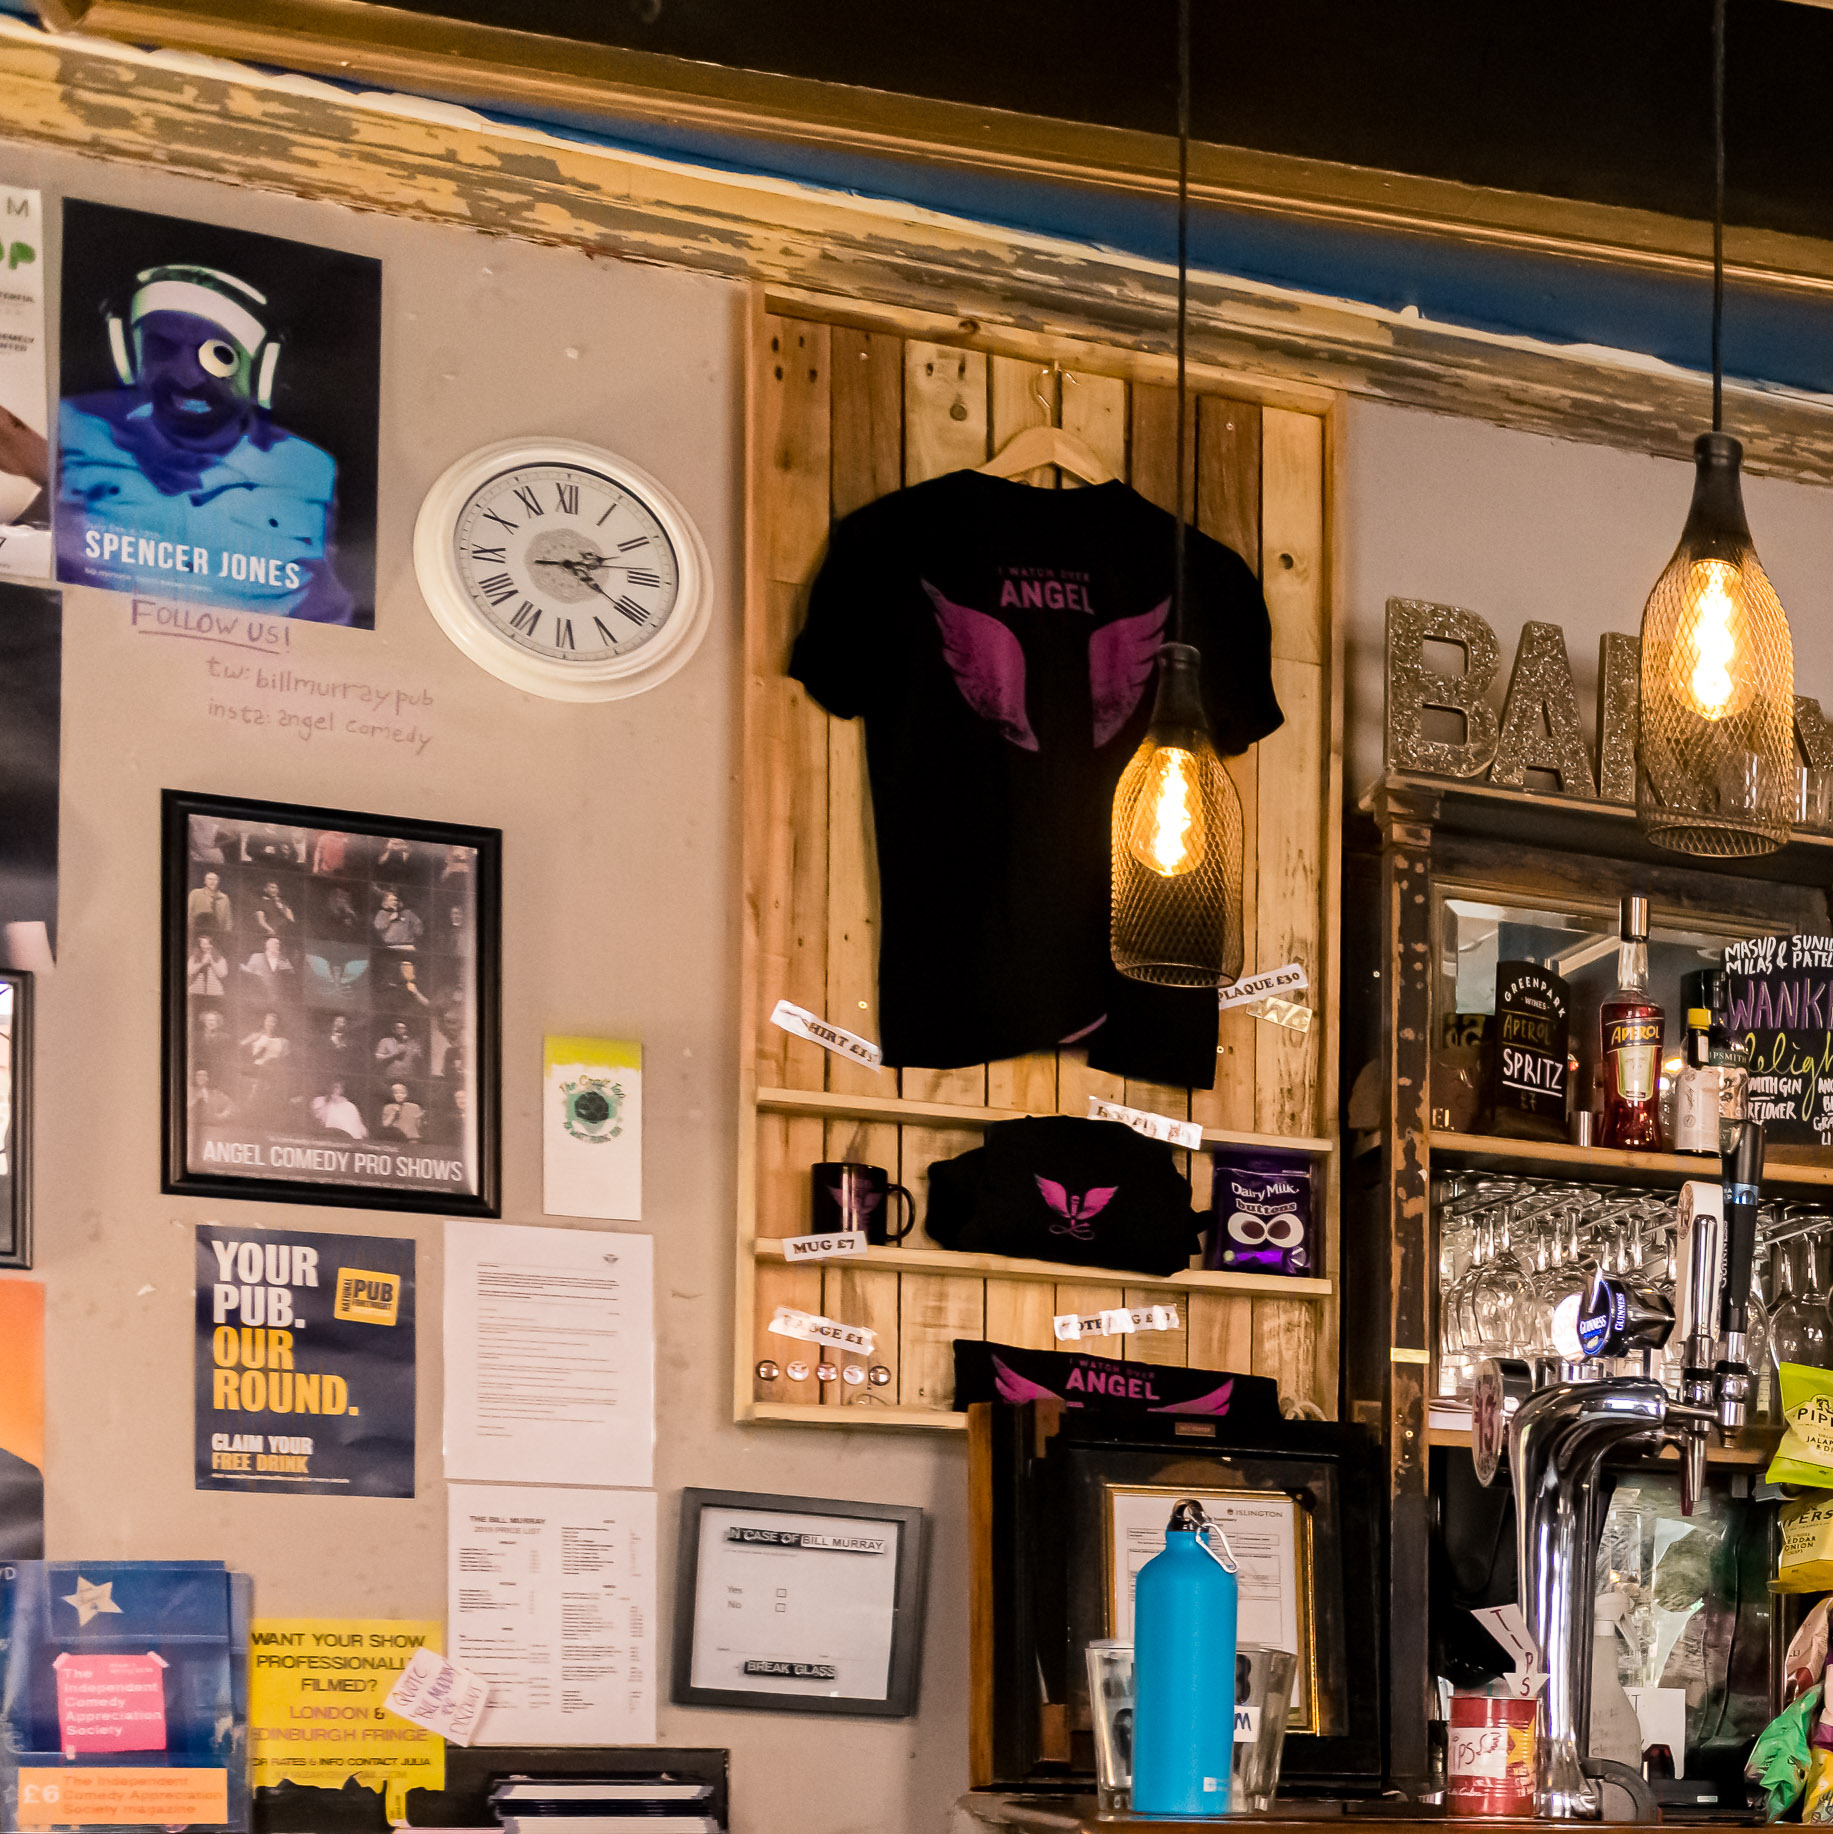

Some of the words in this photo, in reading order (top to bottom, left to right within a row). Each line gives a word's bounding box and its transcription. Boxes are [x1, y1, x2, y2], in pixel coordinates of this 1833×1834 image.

[85, 530, 208, 575] SPENCER
[218, 551, 301, 589] JONES
[1000, 579, 1095, 615] ANGEL
[131, 598, 239, 634] FOLLOW
[247, 621, 291, 653] US!
[1725, 936, 1776, 962] MASUD
[1726, 957, 1773, 975] MILAS
[1792, 950, 1833, 968] PATEL
[1276, 971, 1301, 986] £30
[1504, 976, 1566, 1018] GREENPARK
[1504, 1014, 1550, 1046] APEROL
[1611, 1025, 1660, 1045] APEROL
[1503, 1048, 1563, 1089] SPRITZ
[202, 1139, 265, 1167] ANGEL
[270, 1144, 350, 1173] COMEDY
[354, 1152, 391, 1176] PRO
[396, 1154, 463, 1182] SHOWS
[1232, 1182, 1265, 1201] Dairy
[1236, 1198, 1297, 1215] buttons
[792, 1240, 832, 1254] MUG
[837, 1239, 855, 1249] £7
[211, 1240, 319, 1287] YOUR
[353, 1279, 394, 1303] PUB
[213, 1284, 306, 1328] PUB.
[1614, 1292, 1626, 1331] GUINNESS
[1579, 1314, 1607, 1334] GUINNESS
[213, 1326, 294, 1370] OUR
[845, 1333, 863, 1345] £1
[213, 1369, 359, 1416] ROUND.
[1066, 1368, 1160, 1400] ANGEL
[211, 1433, 264, 1452] CLAIM
[268, 1436, 314, 1454] YOUR
[212, 1452, 251, 1471] FREE
[256, 1453, 309, 1473] DRINK
[1235, 1509, 1283, 1518] ISLINGTON
[743, 1530, 778, 1542] CASE
[780, 1532, 800, 1543] OF
[802, 1535, 828, 1546] BILL
[832, 1538, 883, 1550] MURRAY
[252, 1633, 305, 1646] WANT
[312, 1633, 364, 1647] YOUR
[369, 1634, 426, 1648] SHOW
[1490, 1609, 1533, 1697] TIPS
[64, 1668, 93, 1679] The
[747, 1660, 789, 1674] BREAK
[793, 1663, 835, 1677] GLASS
[64, 1681, 158, 1694] Independent
[301, 1678, 377, 1692] FILMED?
[64, 1696, 127, 1709] Comedy
[66, 1710, 162, 1724] Appreciation
[290, 1706, 368, 1720] LONDON
[66, 1724, 124, 1738] Society
[362, 1728, 428, 1741] FRINGE
[96, 1775, 188, 1786] Independent
[23, 1784, 60, 1804] £6
[129, 1790, 223, 1802] Appreciation
